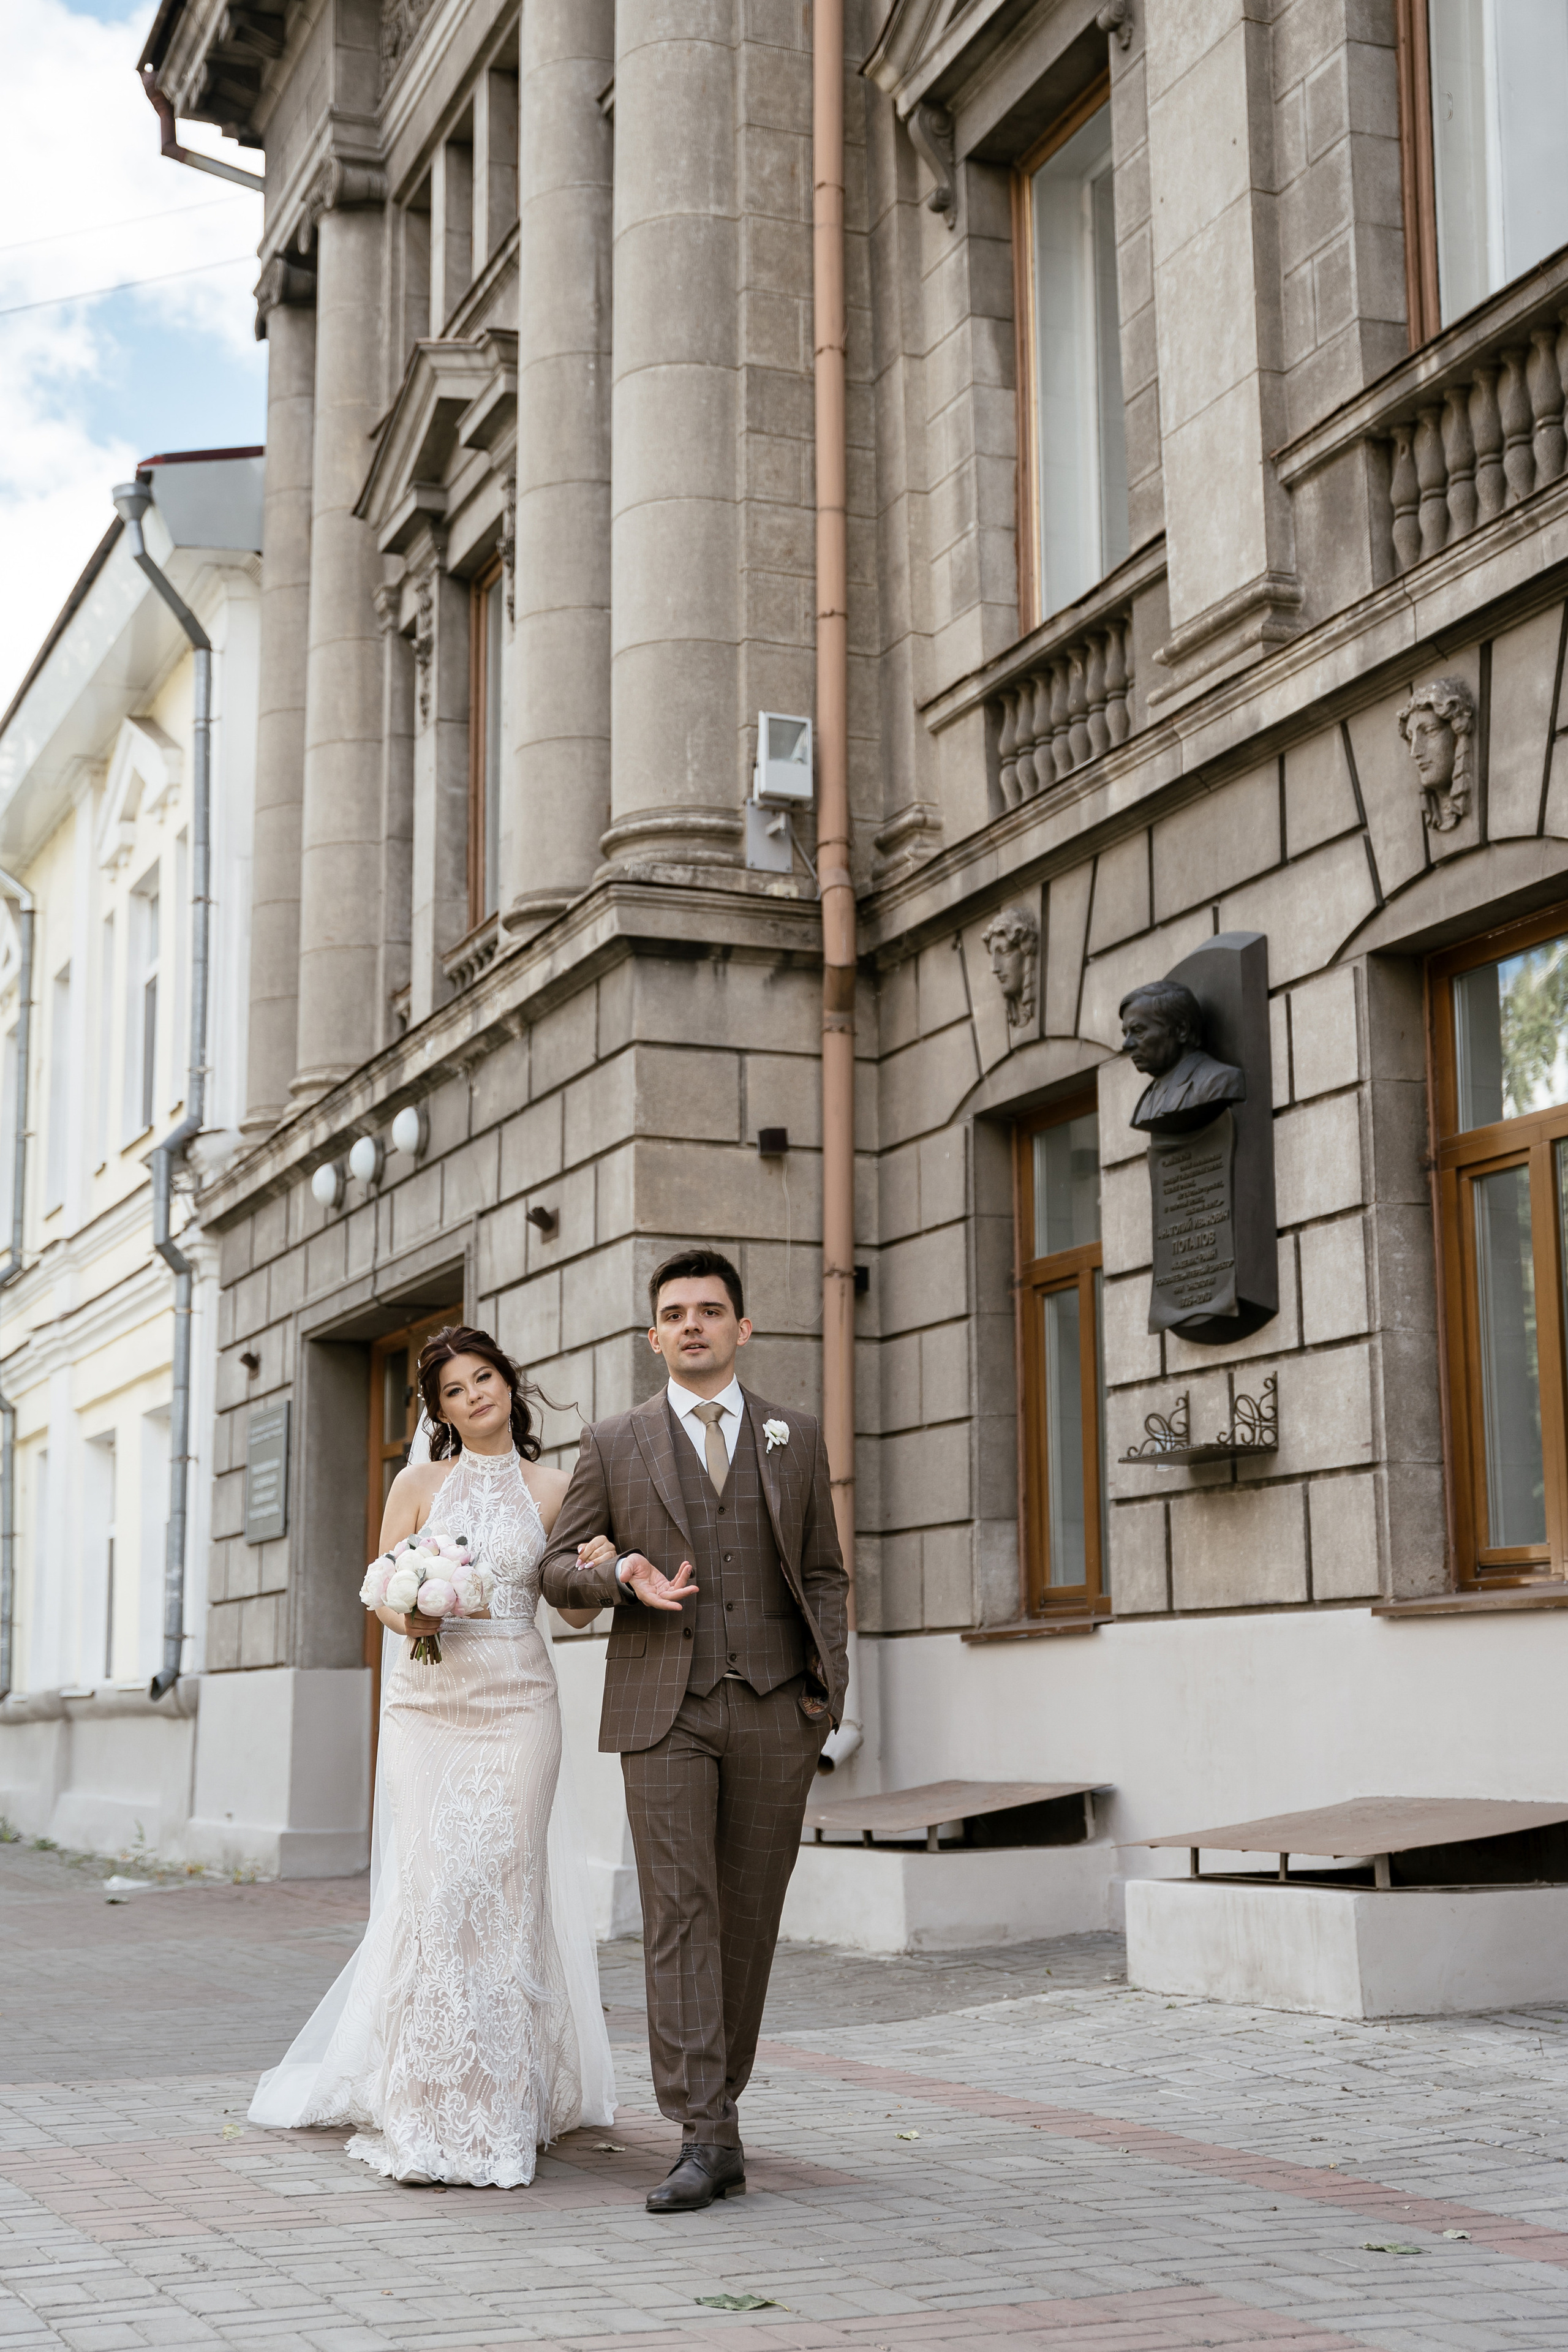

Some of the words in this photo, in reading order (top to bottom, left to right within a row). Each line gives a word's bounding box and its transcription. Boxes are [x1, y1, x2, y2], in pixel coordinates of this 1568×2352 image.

[1157, 1217, 1192, 1240] АНАТОЛИЙ
[1194, 1208, 1230, 1230] ИВАНОВИЧ
[1172, 1229, 1215, 1256] ПОТАПОВ
